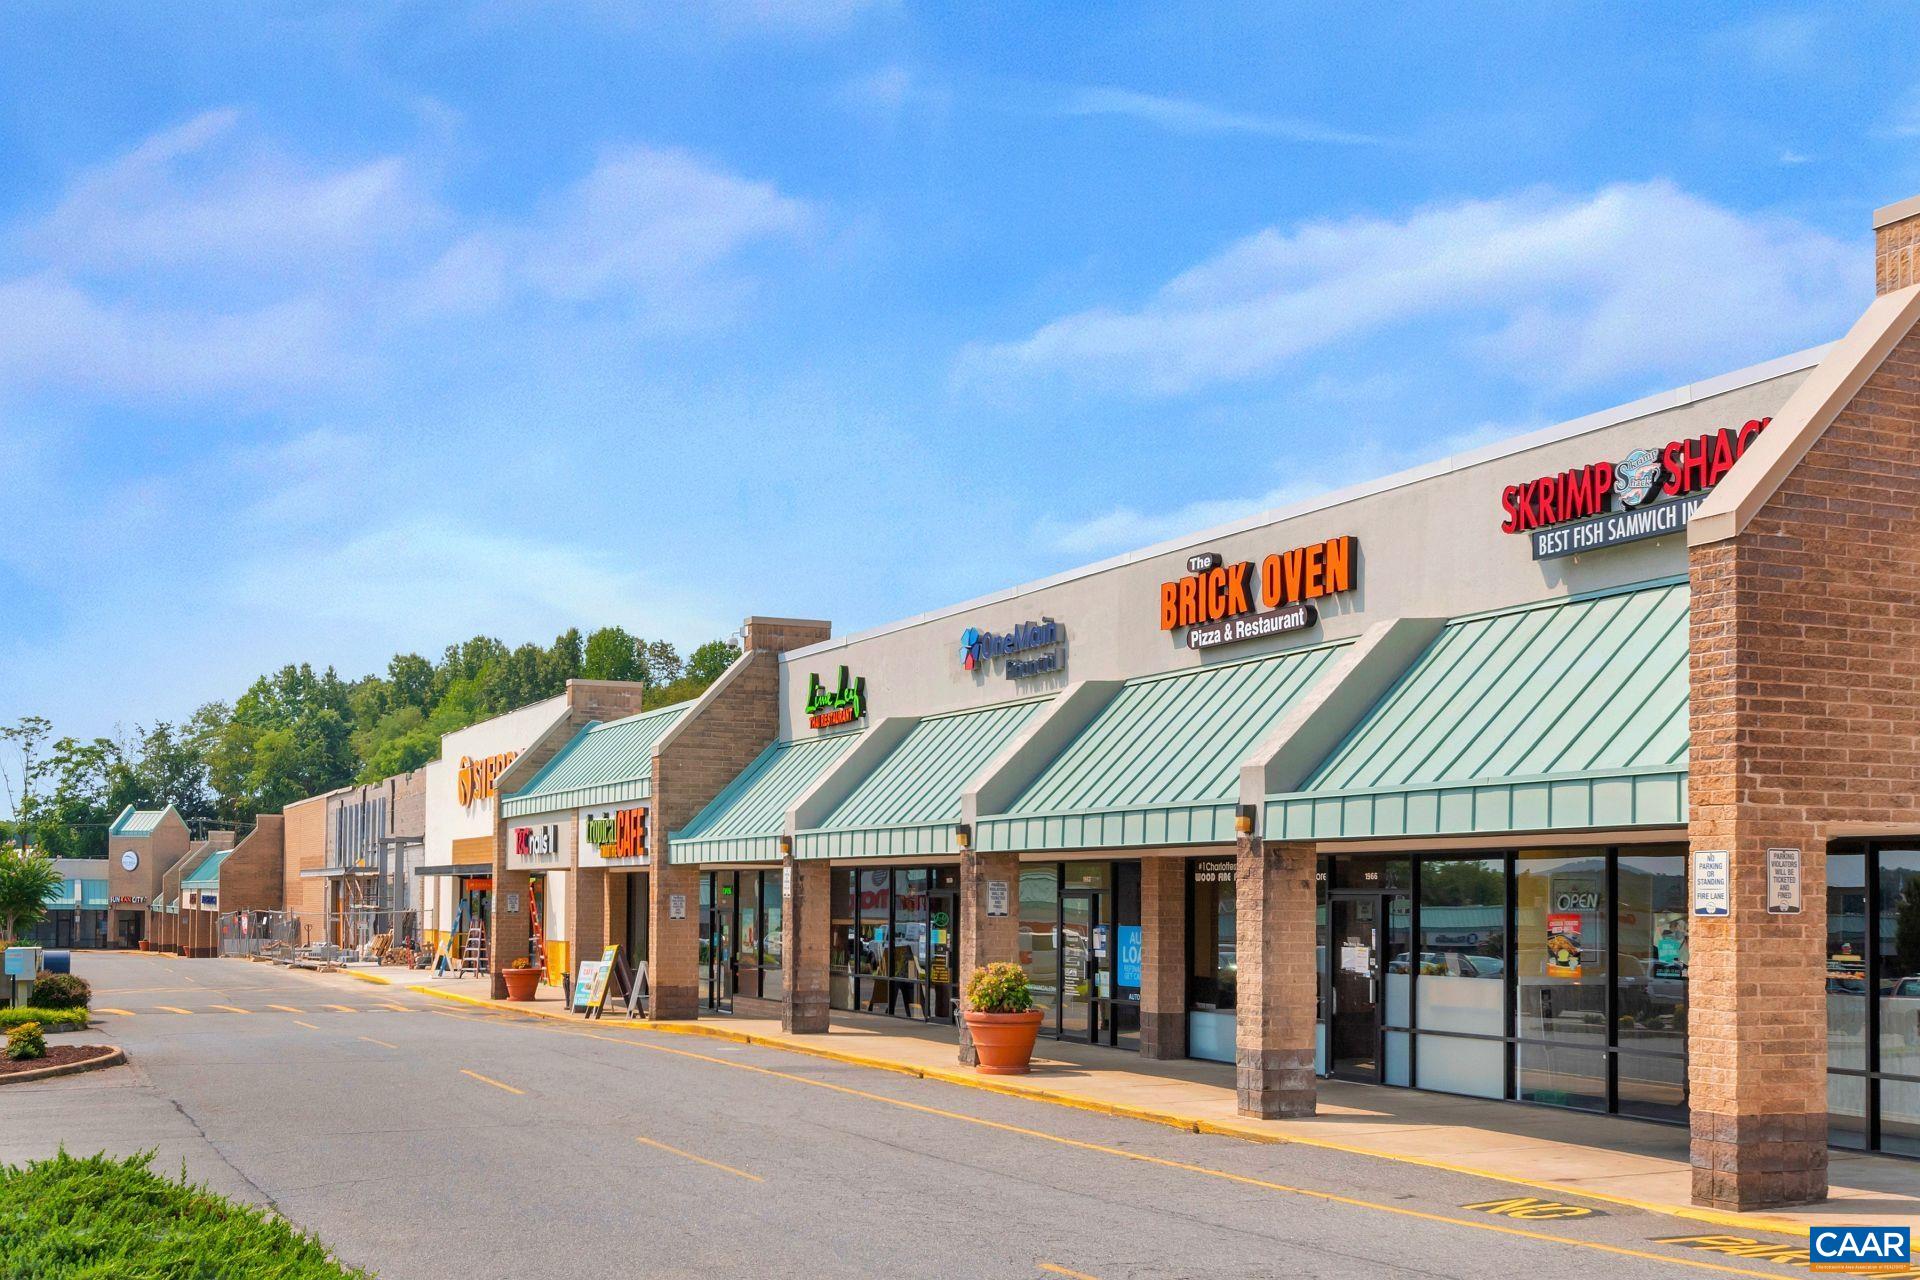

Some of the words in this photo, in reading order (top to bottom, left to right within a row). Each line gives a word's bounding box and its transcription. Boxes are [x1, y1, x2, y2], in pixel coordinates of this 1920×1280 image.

[1501, 461, 1613, 534] SKRIMP
[1663, 416, 1772, 496] SHAC
[1538, 531, 1569, 556] BEST
[1573, 521, 1603, 548] FISH
[1608, 506, 1676, 540] SAMWICH
[1161, 561, 1252, 630] BRICK
[1262, 536, 1354, 608] OVEN
[1190, 555, 1212, 571] The
[981, 617, 1061, 659] OneMain
[1191, 630, 1221, 648] Pizza
[1224, 623, 1233, 641] &
[1236, 609, 1305, 637] Restaurant
[616, 807, 646, 858] CAFE
[1195, 872, 1216, 882] WOOD
[1218, 872, 1232, 882] FIRE
[1557, 893, 1598, 911] OPEN
